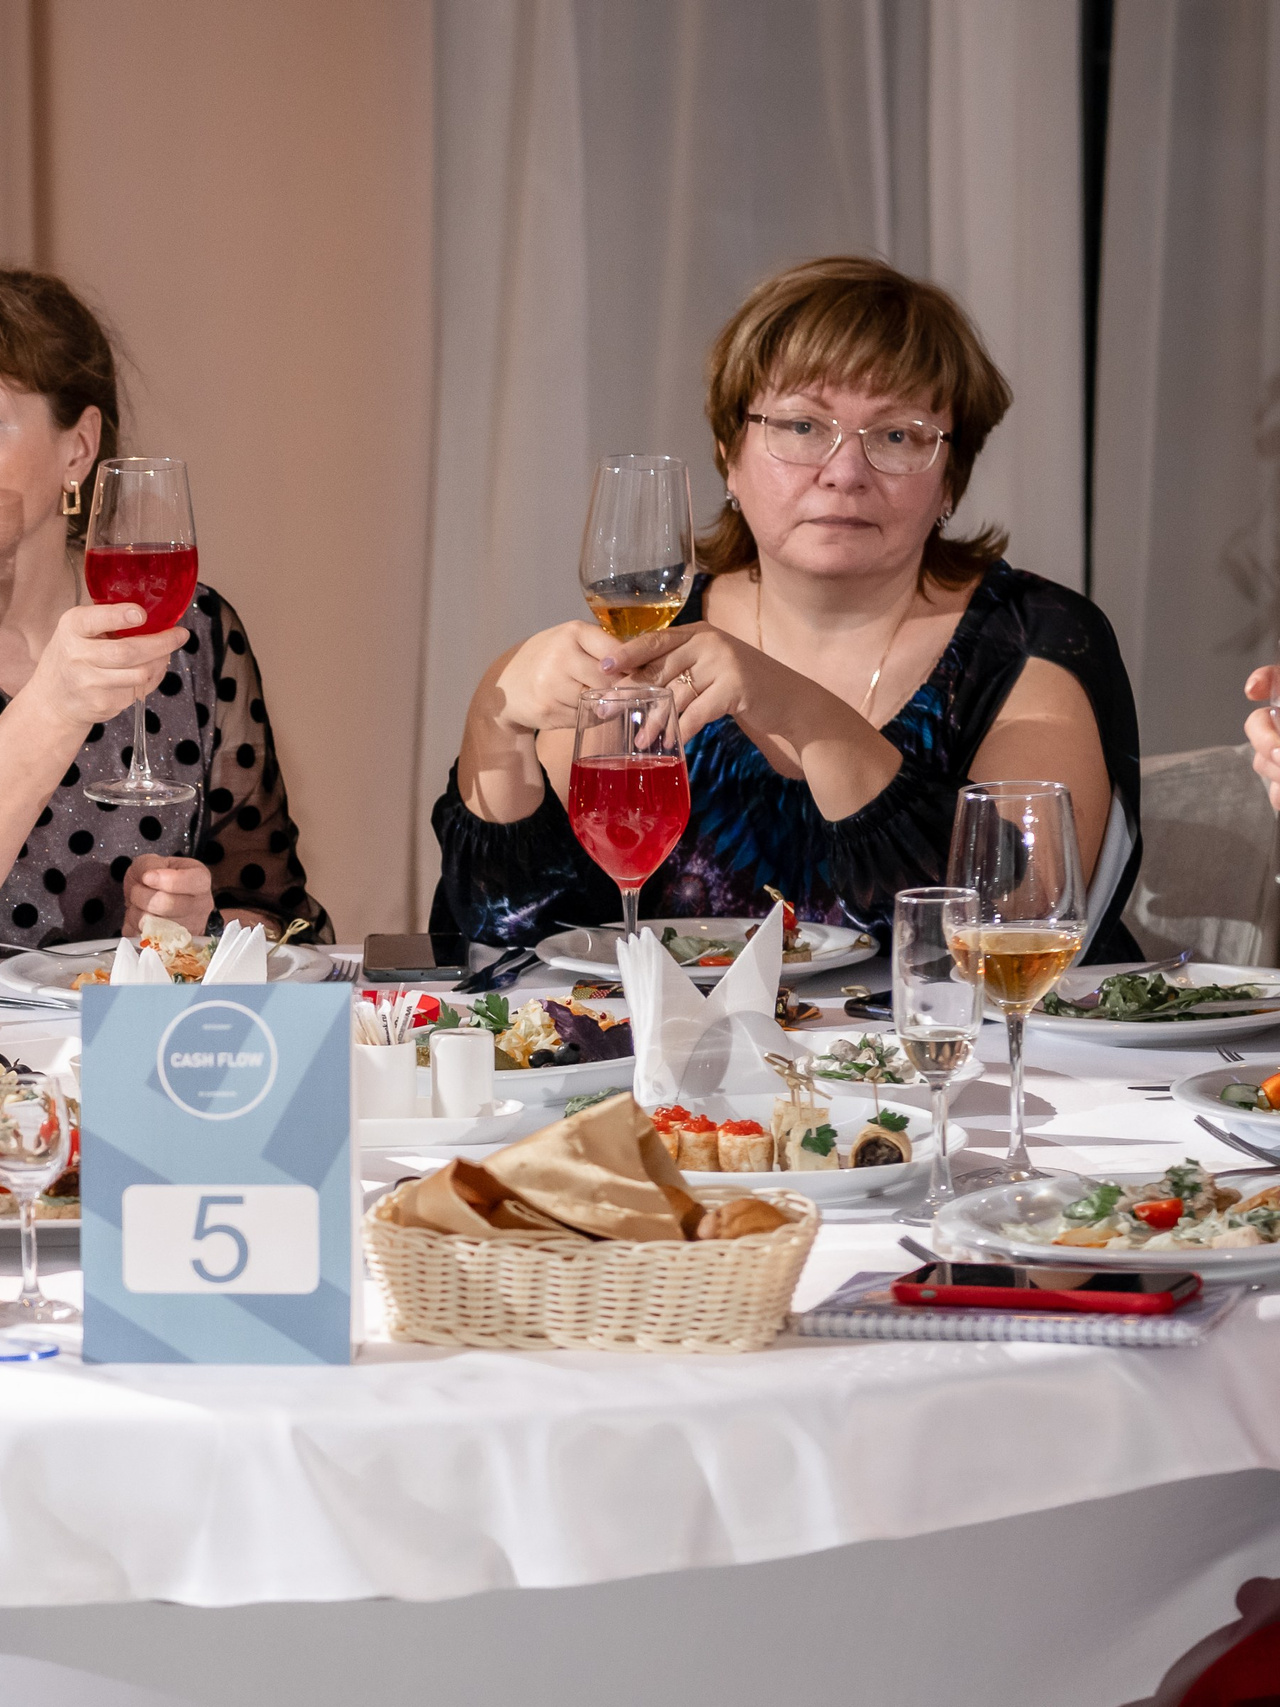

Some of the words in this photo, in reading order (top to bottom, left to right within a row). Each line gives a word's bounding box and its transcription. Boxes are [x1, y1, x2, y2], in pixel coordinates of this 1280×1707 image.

[170, 1052, 215, 1068] CASH
[217, 1052, 264, 1068] FLOW
[191, 1195, 249, 1283] 5
